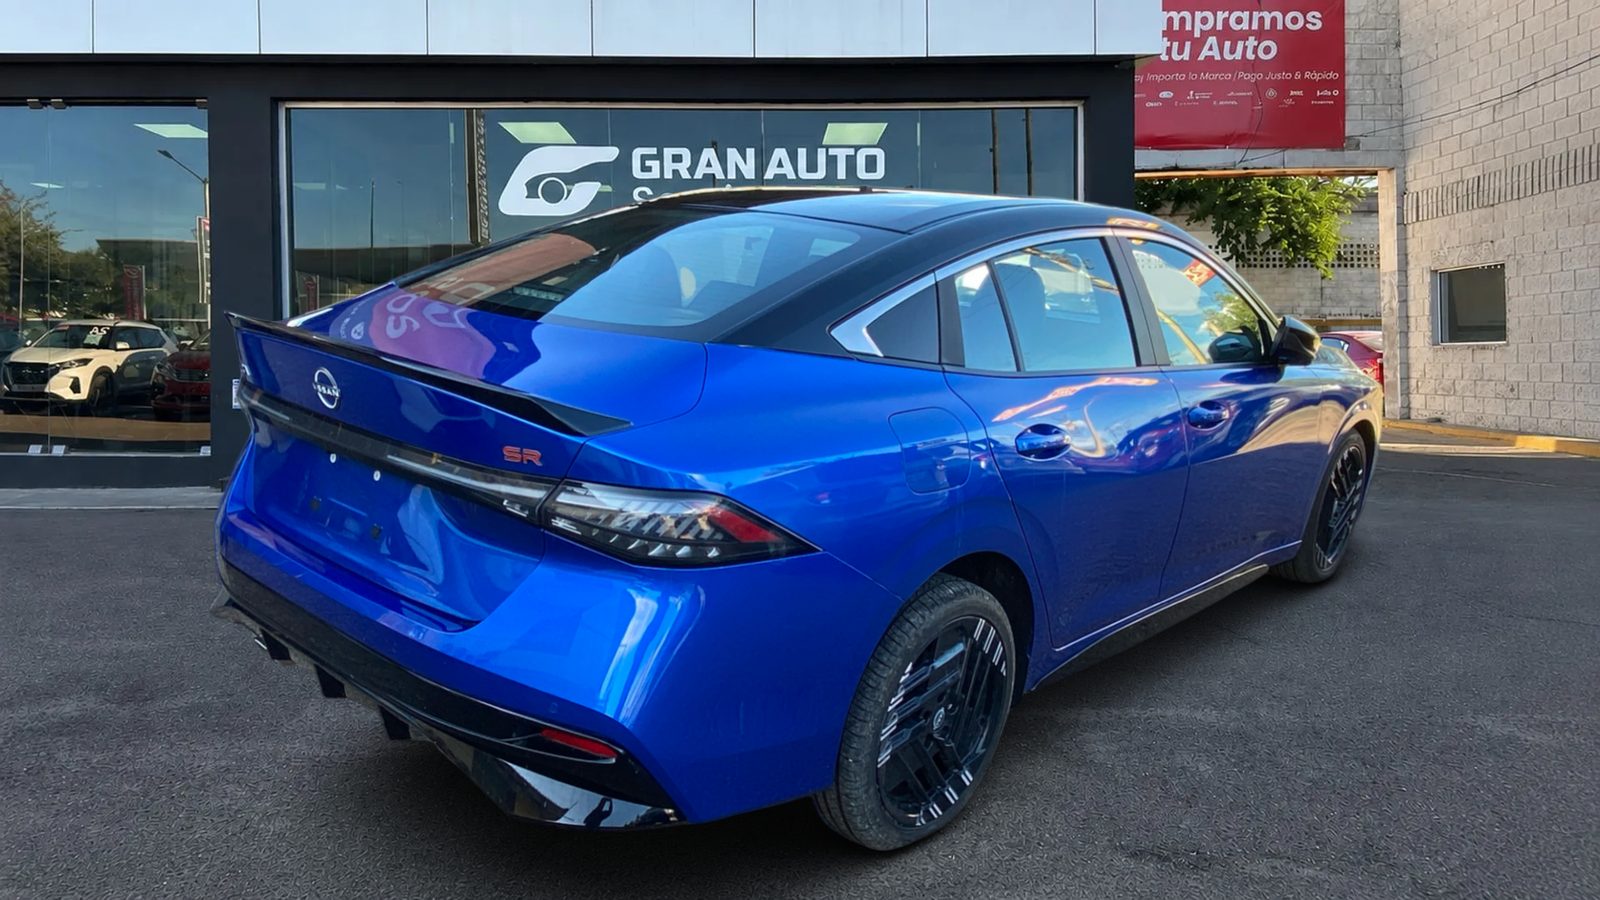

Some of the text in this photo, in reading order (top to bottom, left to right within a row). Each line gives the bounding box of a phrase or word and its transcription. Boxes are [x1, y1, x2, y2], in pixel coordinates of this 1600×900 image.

[1160, 36, 1278, 61] tu Auto
[1146, 72, 1186, 83] Importa
[1199, 72, 1232, 80] Marca
[1266, 72, 1293, 80] Justo
[1294, 71, 1302, 80] &
[631, 146, 886, 180] GRAN AUTO
[502, 445, 543, 467] SR
